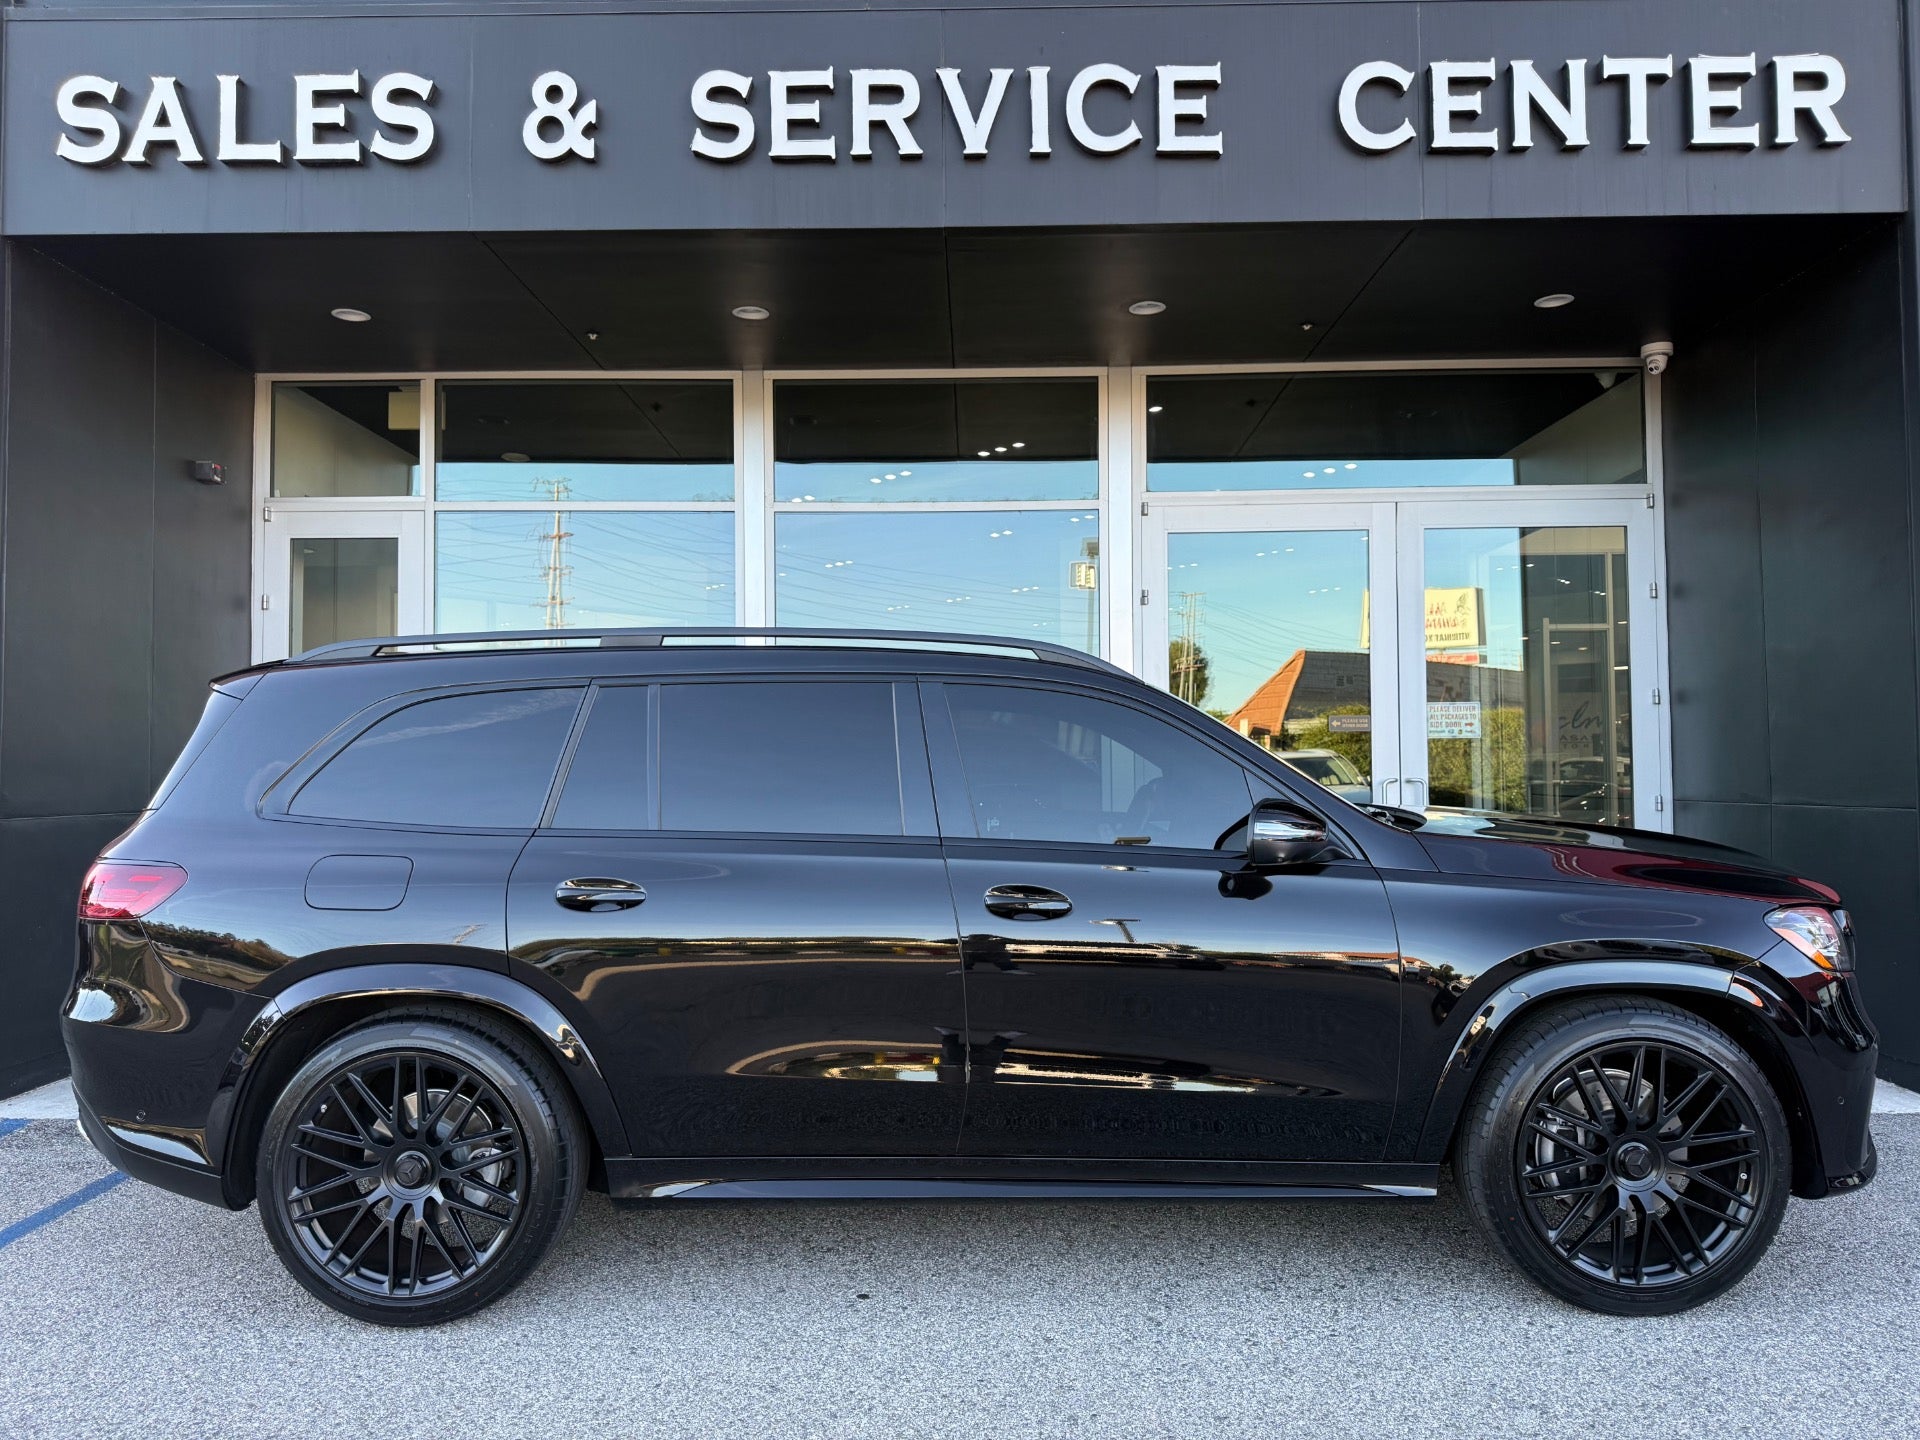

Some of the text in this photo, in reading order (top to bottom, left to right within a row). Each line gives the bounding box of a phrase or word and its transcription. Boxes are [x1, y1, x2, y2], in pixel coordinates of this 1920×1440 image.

[55, 52, 1852, 164] SALES & SERVICE CENTER
[1429, 705, 1450, 713] PLEASE
